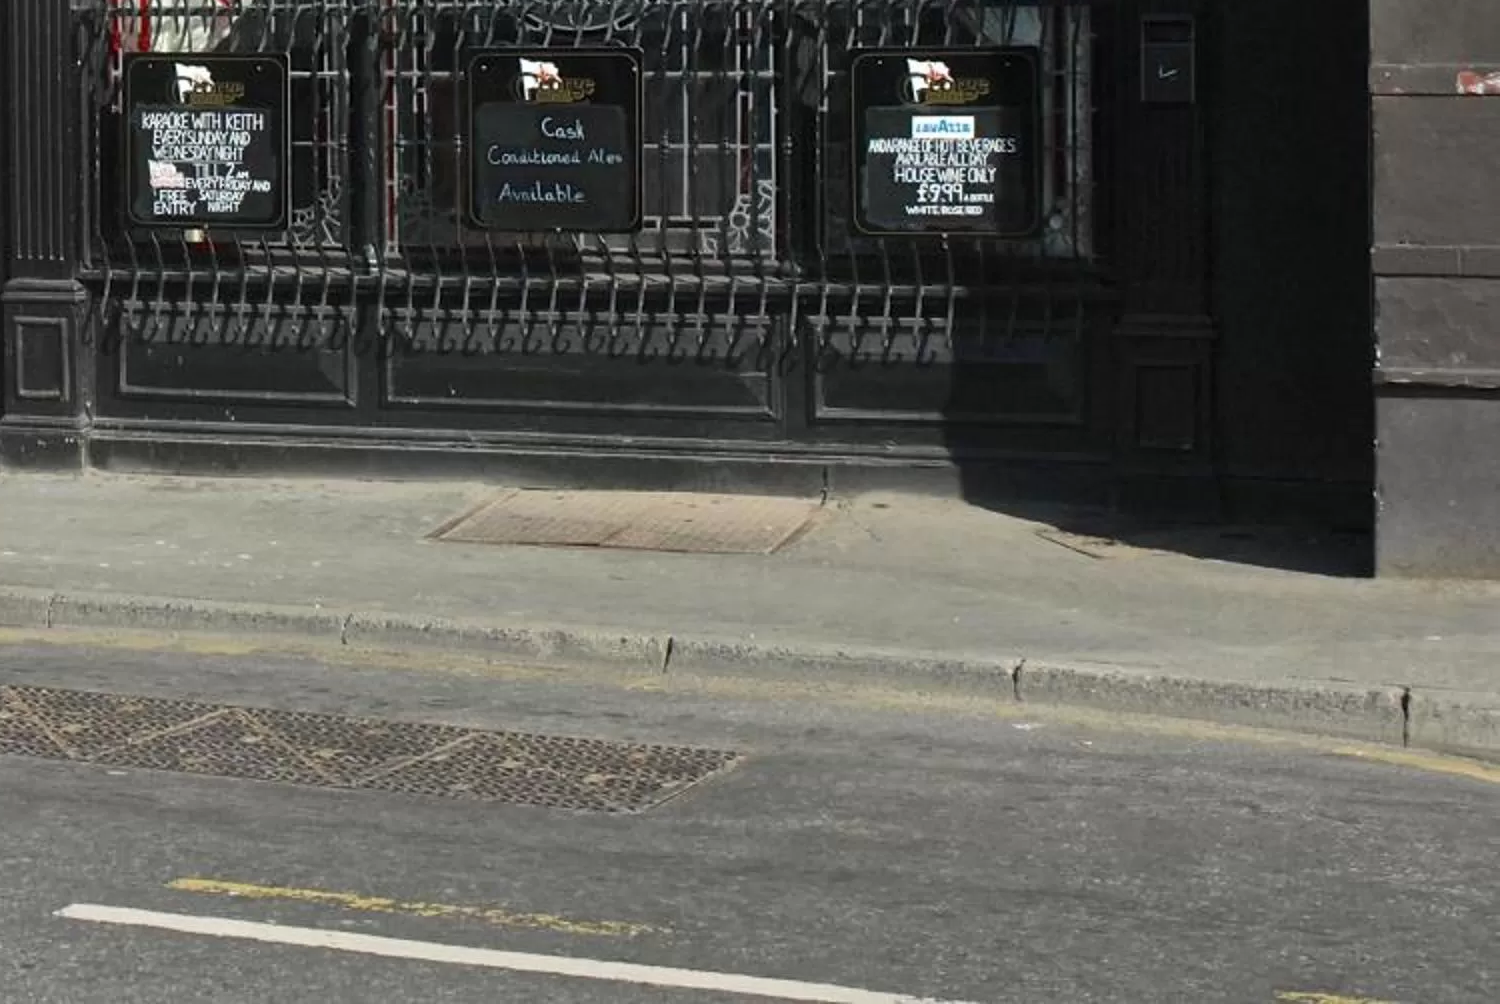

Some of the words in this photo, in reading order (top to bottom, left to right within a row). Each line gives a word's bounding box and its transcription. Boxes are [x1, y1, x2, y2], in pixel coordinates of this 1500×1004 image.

[141, 112, 189, 129] KARAOKE
[191, 112, 221, 130] WITH
[225, 113, 264, 131] KEITH
[540, 115, 586, 141] Cask
[153, 129, 186, 145] EVERY
[187, 130, 228, 146] SUNDAY
[229, 130, 251, 147] AND
[151, 145, 213, 161] WEDNESDAY
[486, 144, 581, 166] Conditioned
[225, 161, 235, 180] 2
[893, 167, 937, 183] HOUSE
[938, 167, 967, 183] WINE
[967, 167, 997, 183] ONLY
[160, 189, 188, 201] FREE
[498, 179, 587, 204] Available
[916, 183, 963, 203] £9.99
[153, 200, 198, 216] ENTRY
[207, 200, 241, 213] NIGHT
